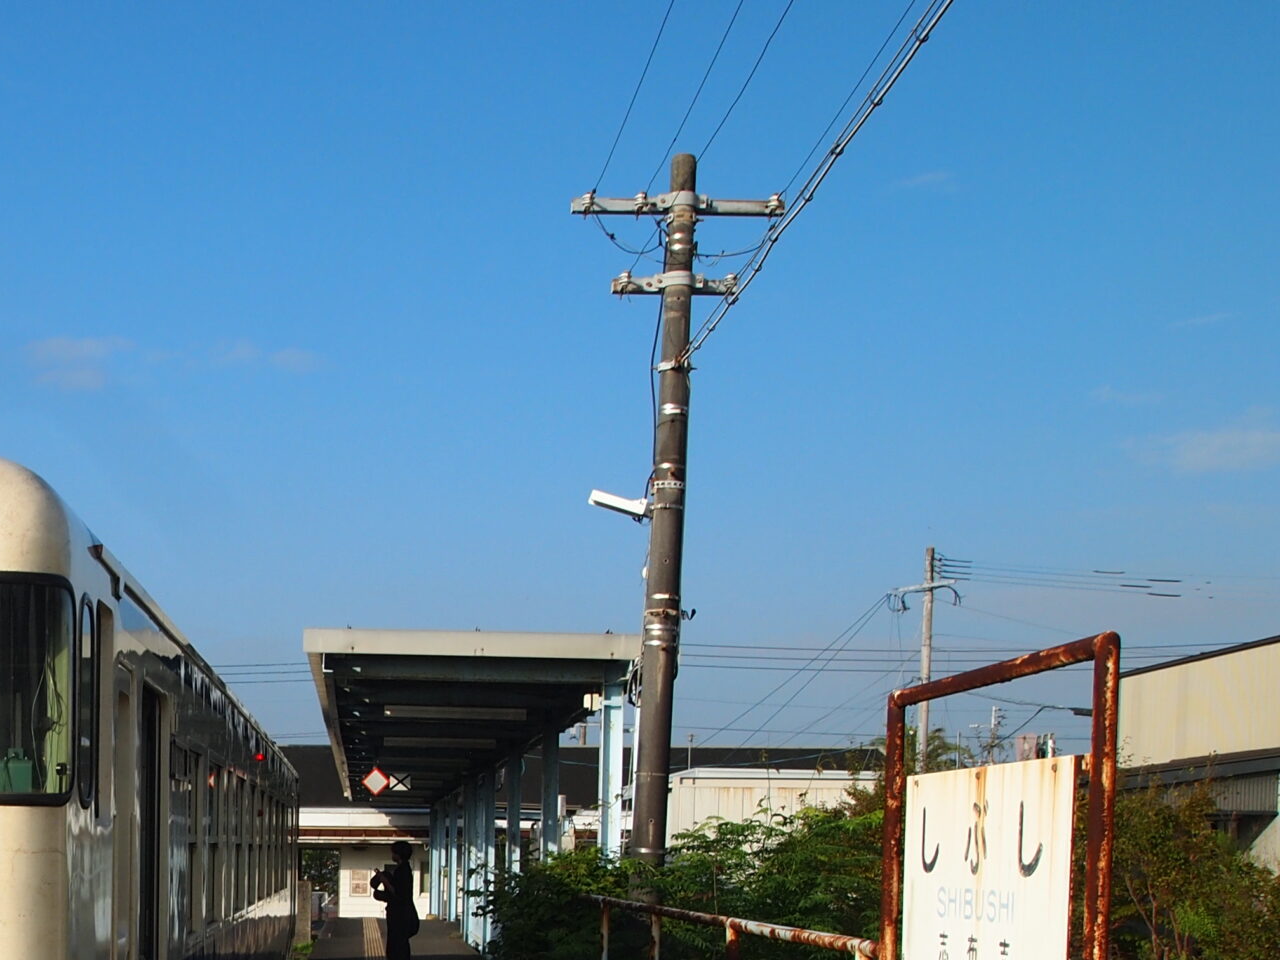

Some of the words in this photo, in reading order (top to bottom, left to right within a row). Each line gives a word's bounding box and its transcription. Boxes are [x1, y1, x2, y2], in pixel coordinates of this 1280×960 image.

[921, 799, 1044, 878] しぶし
[936, 886, 1016, 924] SHIBUSHI
